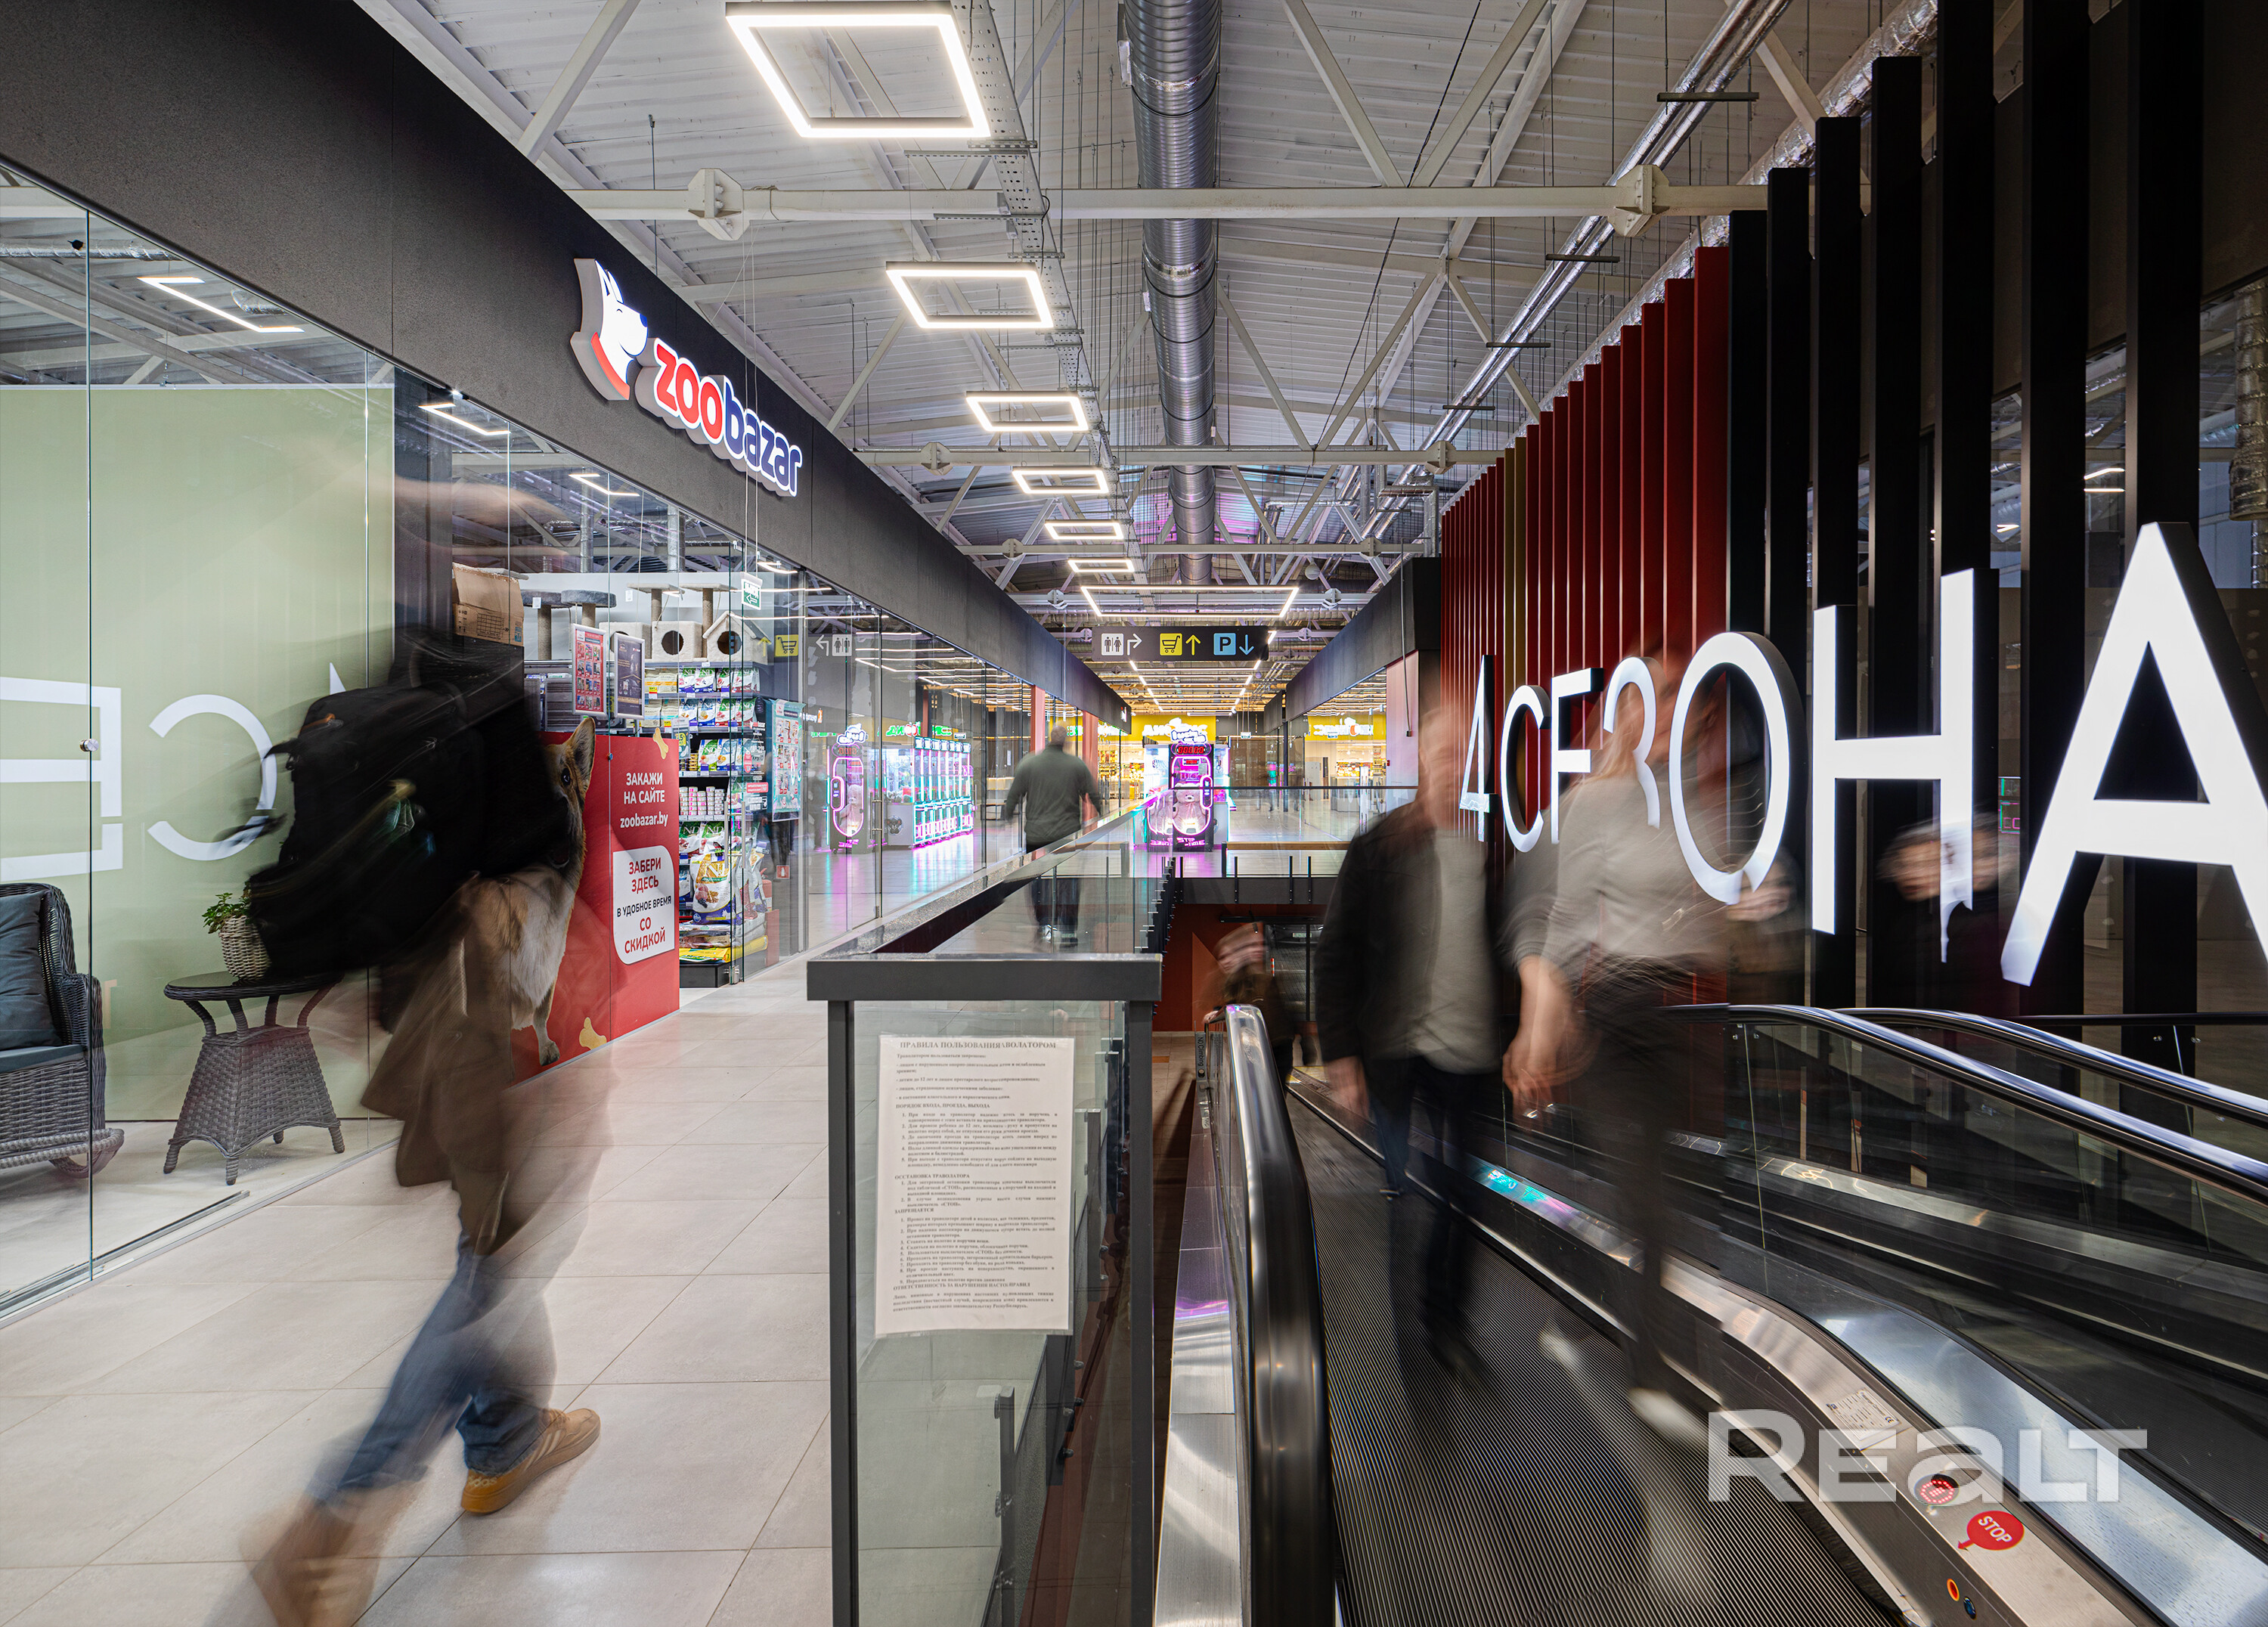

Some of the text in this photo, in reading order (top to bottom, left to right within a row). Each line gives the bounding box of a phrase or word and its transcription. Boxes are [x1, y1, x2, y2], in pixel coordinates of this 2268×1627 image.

[655, 339, 802, 496] zoobazar
[1220, 637, 1231, 652] P
[626, 772, 663, 786] ЗАКАЖИ
[624, 789, 665, 804] НА САЙТЕ
[620, 813, 668, 829] zoobazar.by
[629, 857, 662, 875] ЗАБЕРИ
[631, 875, 658, 894] ЗДЕСЬ
[617, 895, 671, 918] В УДОБНОЕ ВРЕМЯ
[640, 916, 651, 931] СО
[624, 926, 665, 954] СКИДКОЙ
[1978, 1516, 2012, 1542] STOP
